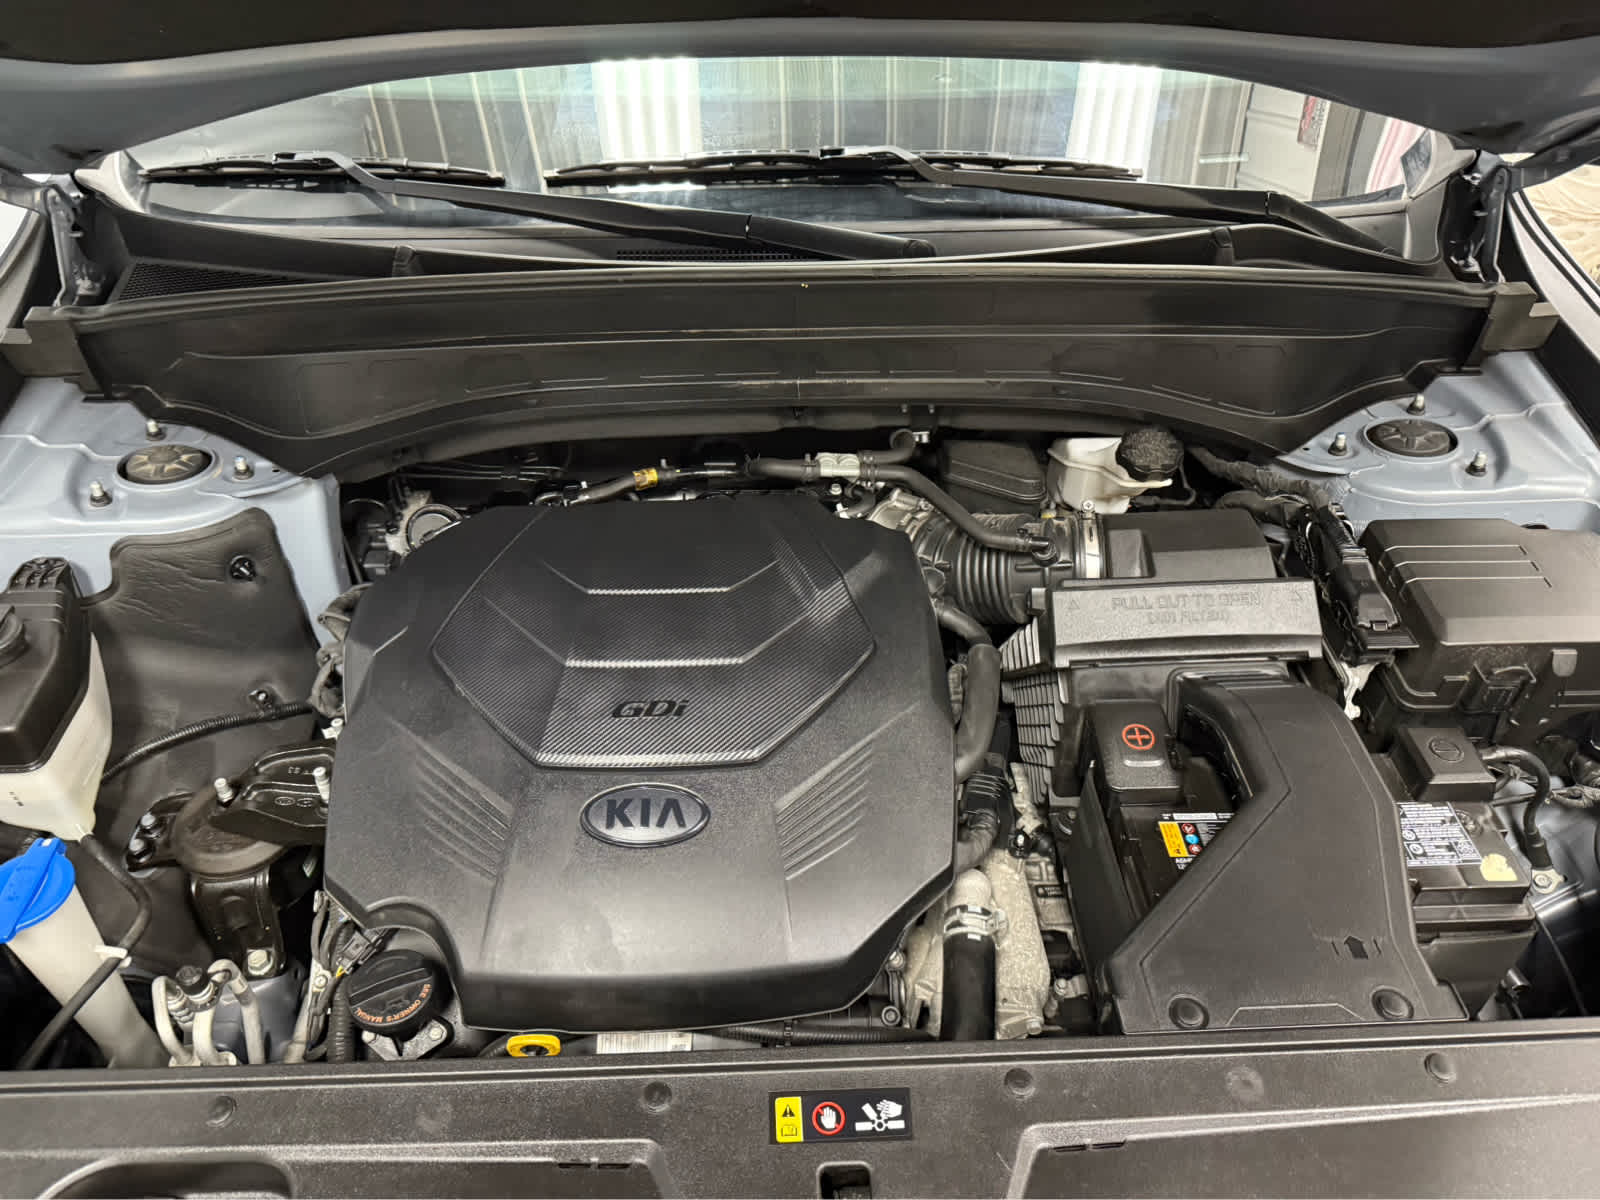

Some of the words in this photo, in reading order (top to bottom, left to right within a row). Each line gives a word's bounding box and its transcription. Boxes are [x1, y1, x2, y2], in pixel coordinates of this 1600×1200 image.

[1111, 596, 1153, 610] PULL
[612, 700, 689, 719] GDi
[605, 798, 687, 829] KIA
